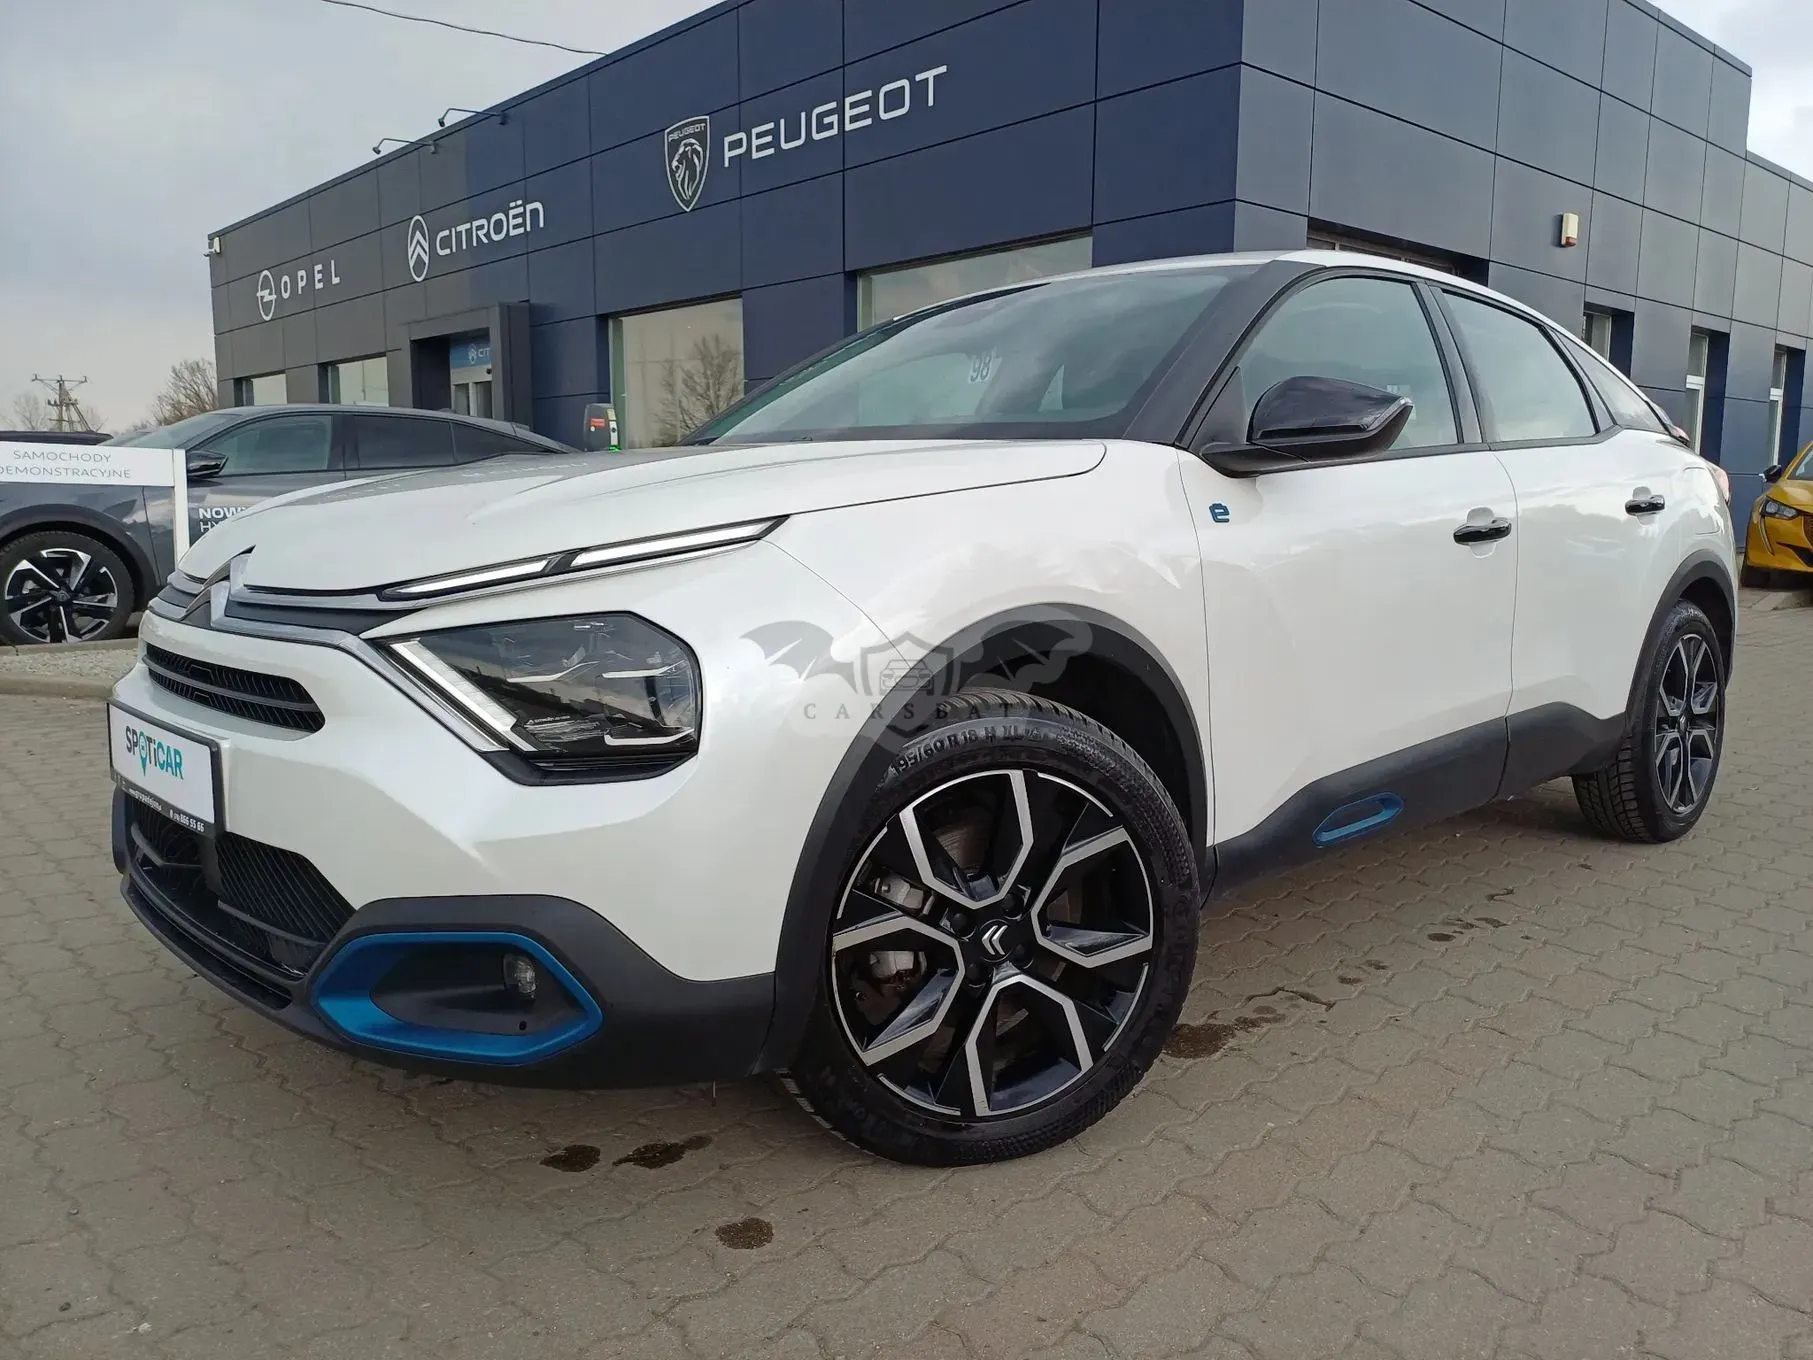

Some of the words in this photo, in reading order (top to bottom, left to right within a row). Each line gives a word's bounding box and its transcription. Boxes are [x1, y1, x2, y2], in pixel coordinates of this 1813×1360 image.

[723, 64, 948, 168] PEUGEOT
[668, 123, 706, 142] PEUGEOT
[280, 258, 342, 300] OPEL
[13, 450, 112, 463] SAMOCHODY
